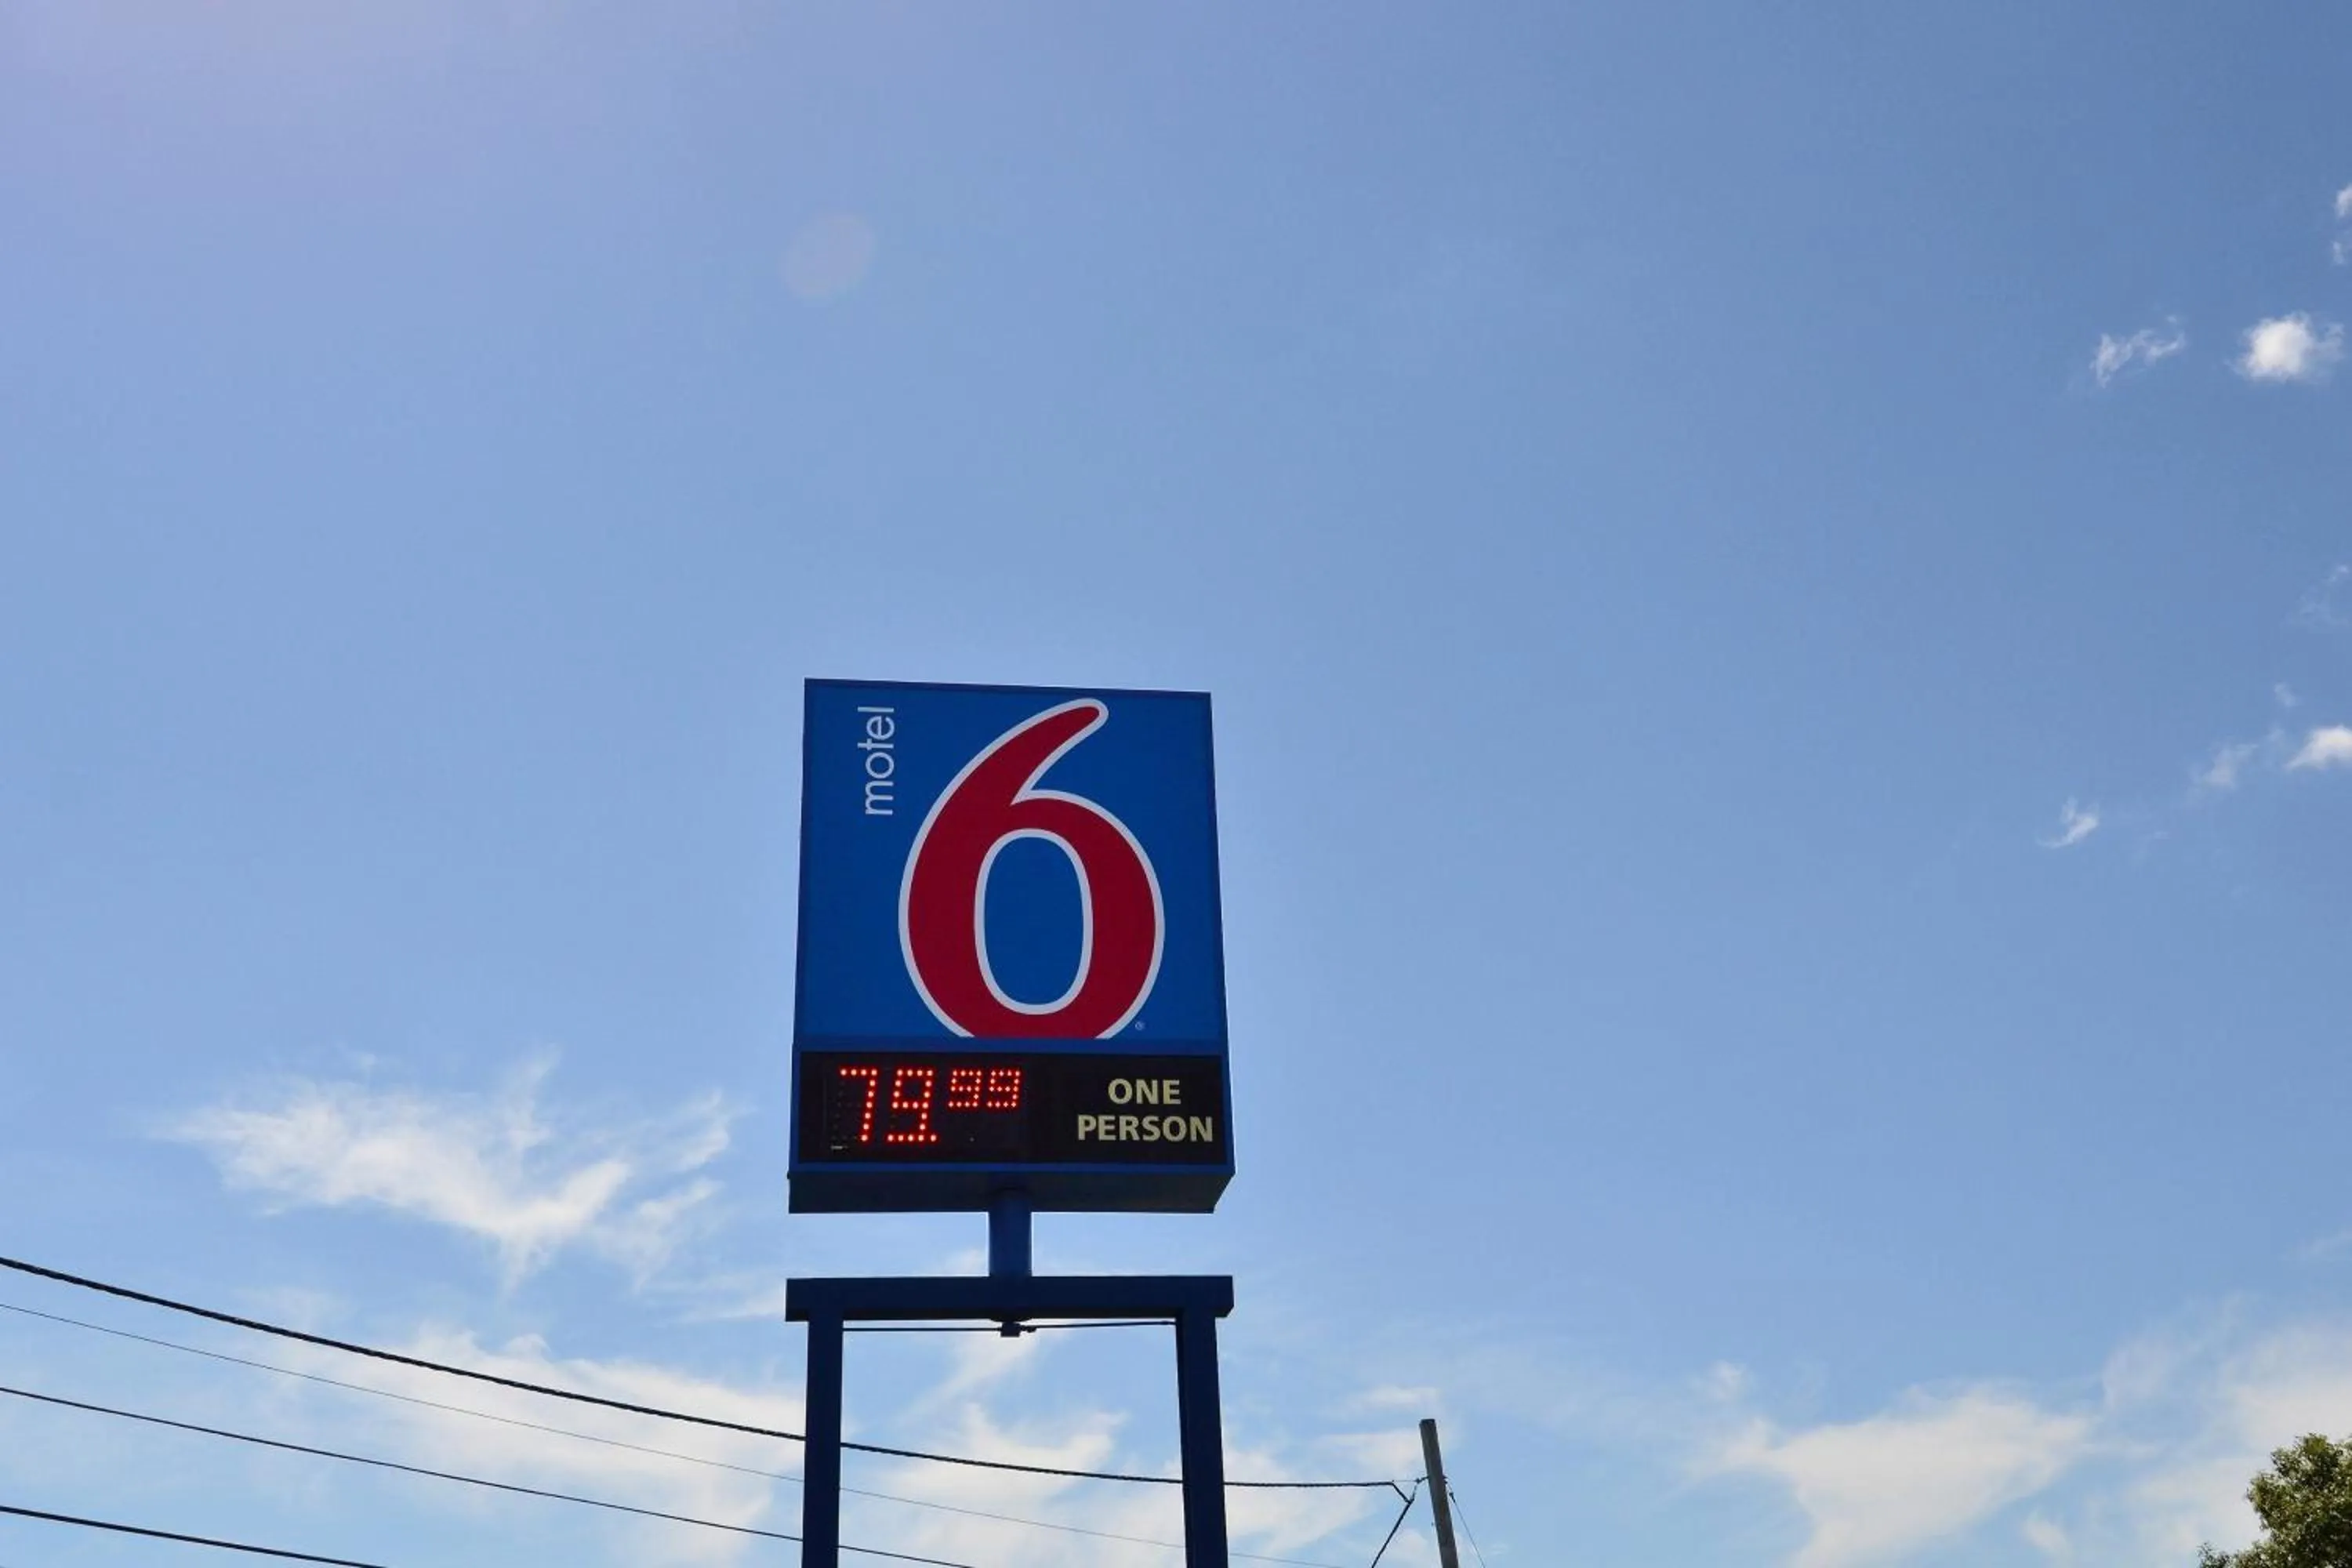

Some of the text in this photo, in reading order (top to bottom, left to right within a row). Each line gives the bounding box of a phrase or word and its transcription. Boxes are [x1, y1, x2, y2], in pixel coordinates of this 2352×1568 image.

[857, 706, 895, 816] motel
[898, 698, 1165, 1040] 6
[1107, 1078, 1181, 1105] ONE
[1077, 1114, 1214, 1142] PERSON
